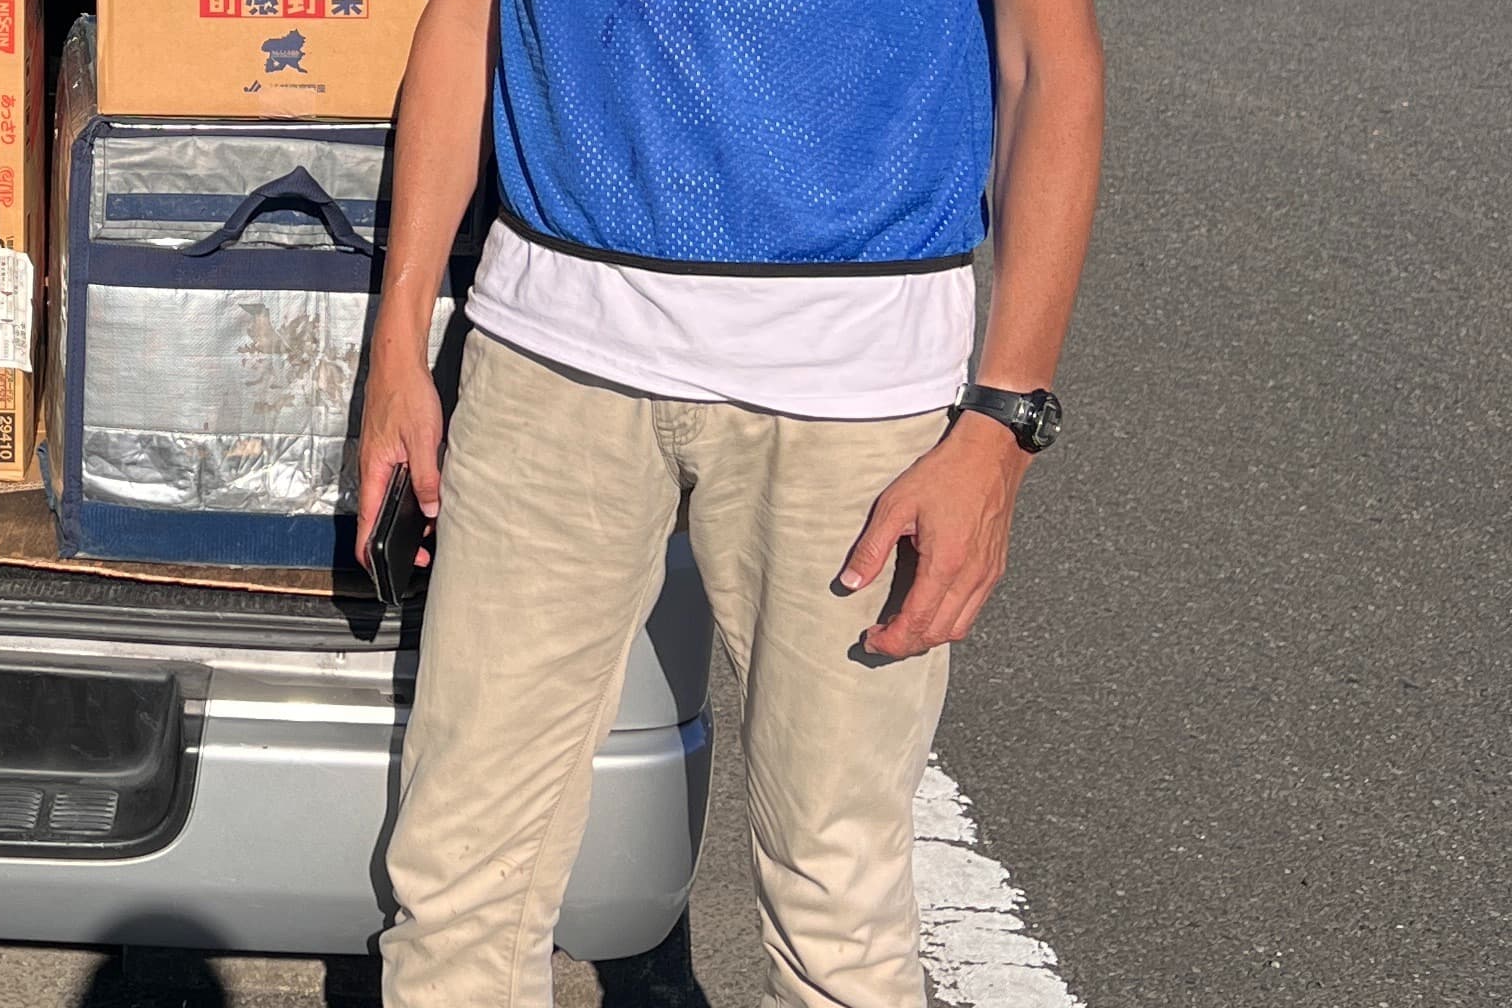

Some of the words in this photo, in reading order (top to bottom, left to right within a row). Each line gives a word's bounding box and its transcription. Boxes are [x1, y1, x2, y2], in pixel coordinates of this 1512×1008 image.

[0, 94, 17, 146] あっさり
[0, 415, 13, 461] 29410
